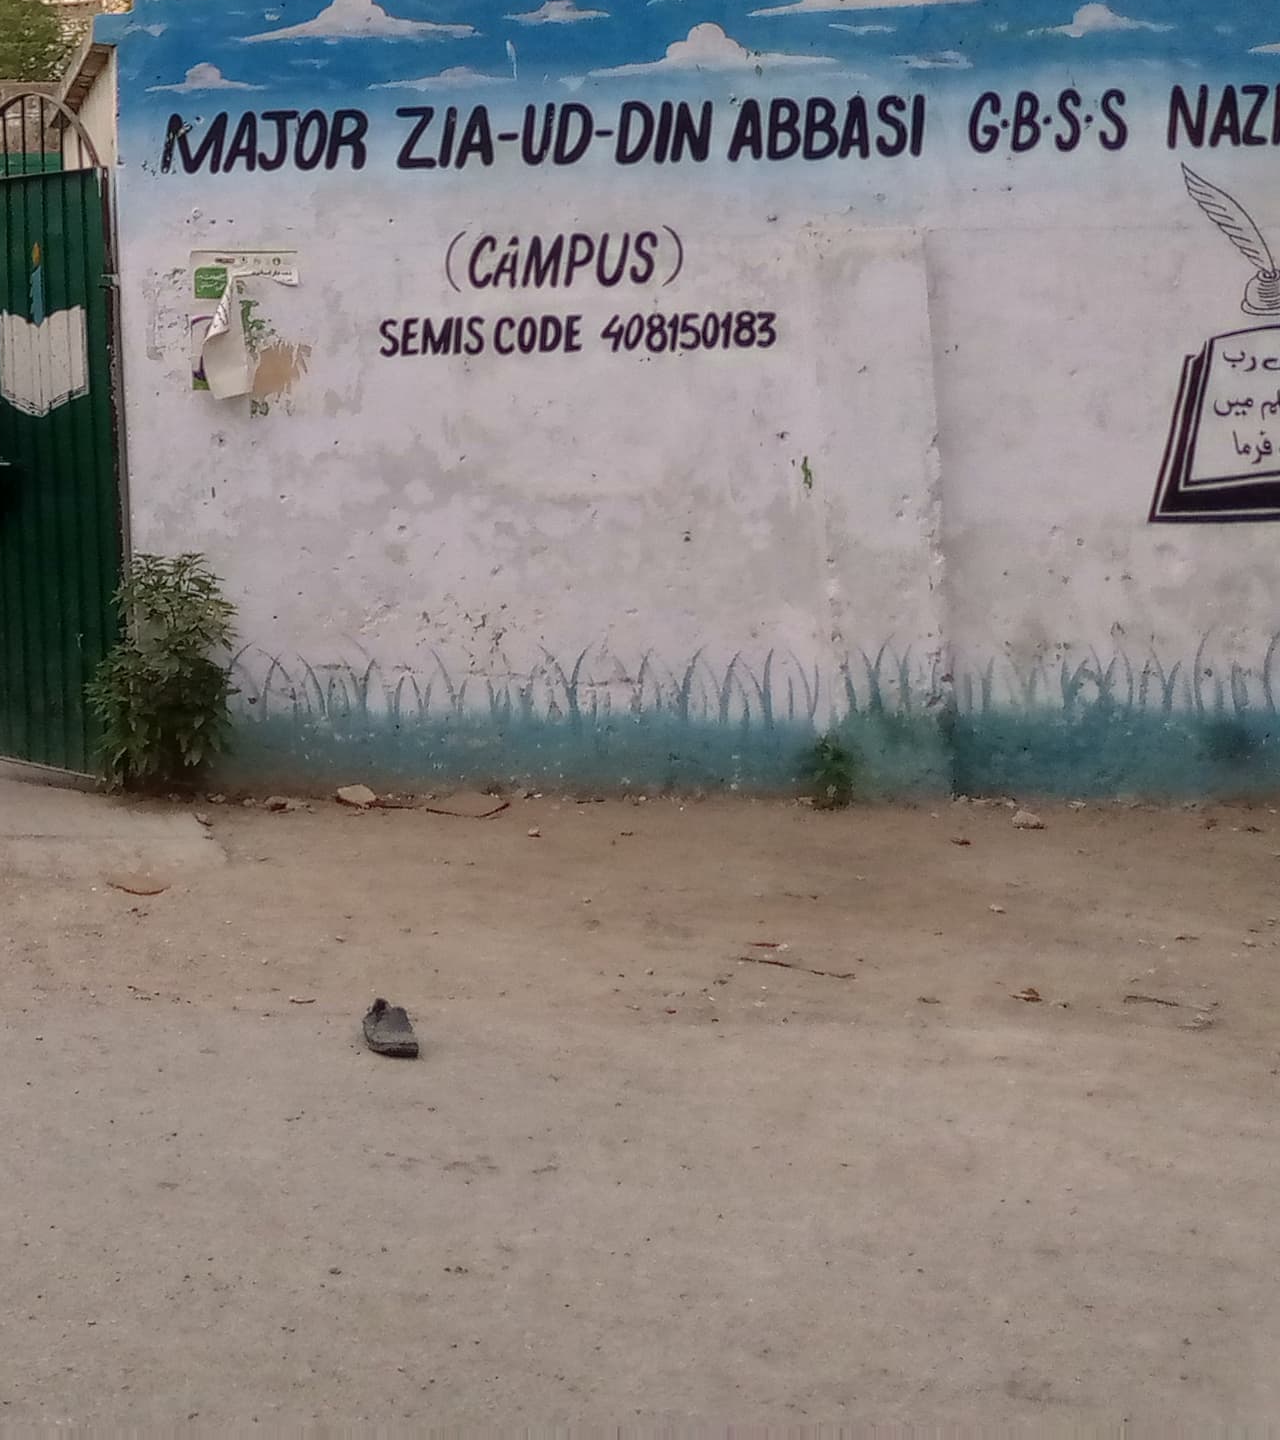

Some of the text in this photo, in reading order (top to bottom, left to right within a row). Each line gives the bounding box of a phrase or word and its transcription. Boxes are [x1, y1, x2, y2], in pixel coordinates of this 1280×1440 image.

[161, 107, 368, 174] MAJOR
[395, 100, 713, 169] ZIA-UD-DIN
[727, 94, 925, 162] ABBASI
[445, 224, 684, 293] (CAMPUS)
[378, 311, 778, 357] SEMIS CODE 408150183
[1222, 349, 1257, 373] رب
[1213, 396, 1254, 417] میں
[1232, 429, 1273, 465] فرما
